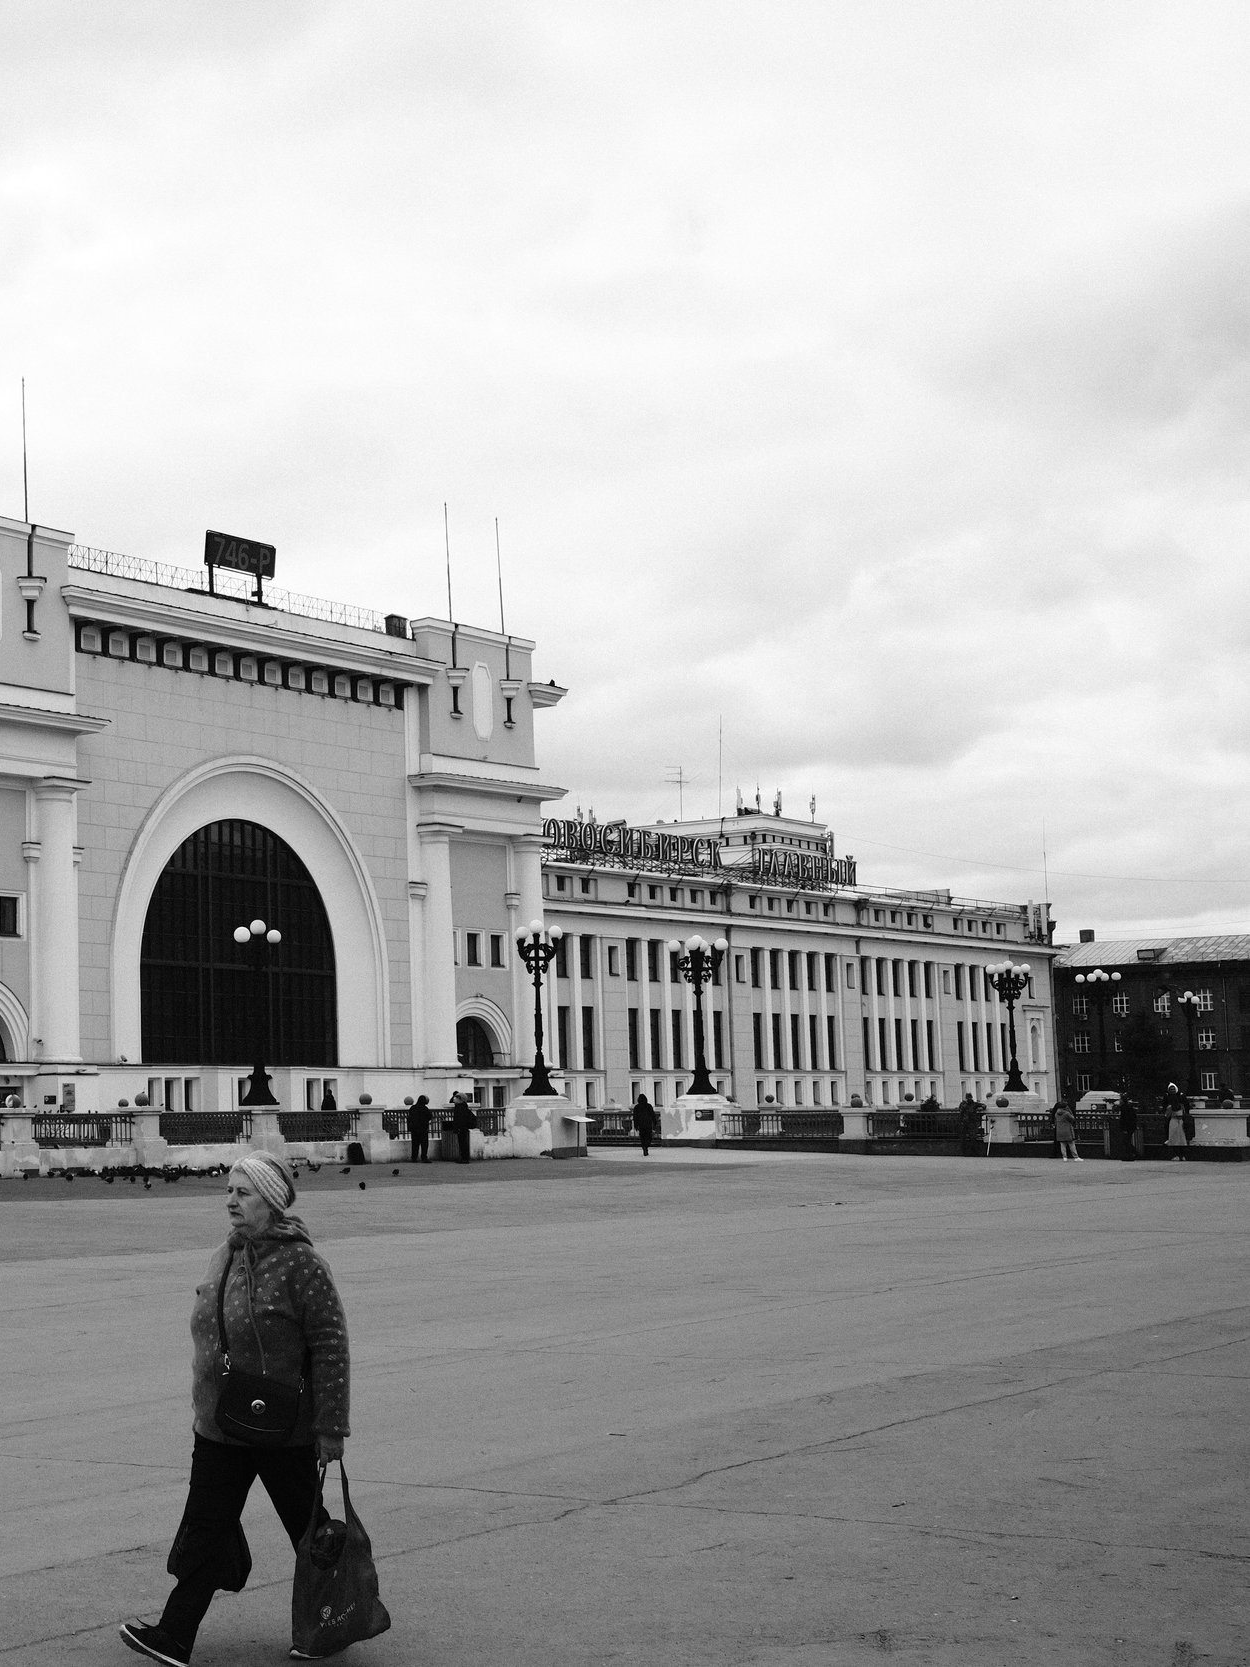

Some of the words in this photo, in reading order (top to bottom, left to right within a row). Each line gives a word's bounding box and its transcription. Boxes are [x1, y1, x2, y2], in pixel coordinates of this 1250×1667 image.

[541, 818, 723, 868] ОВОСИБИРСК
[759, 848, 857, 887] ГЛАВНЫЙ
[319, 1618, 337, 1628] YES
